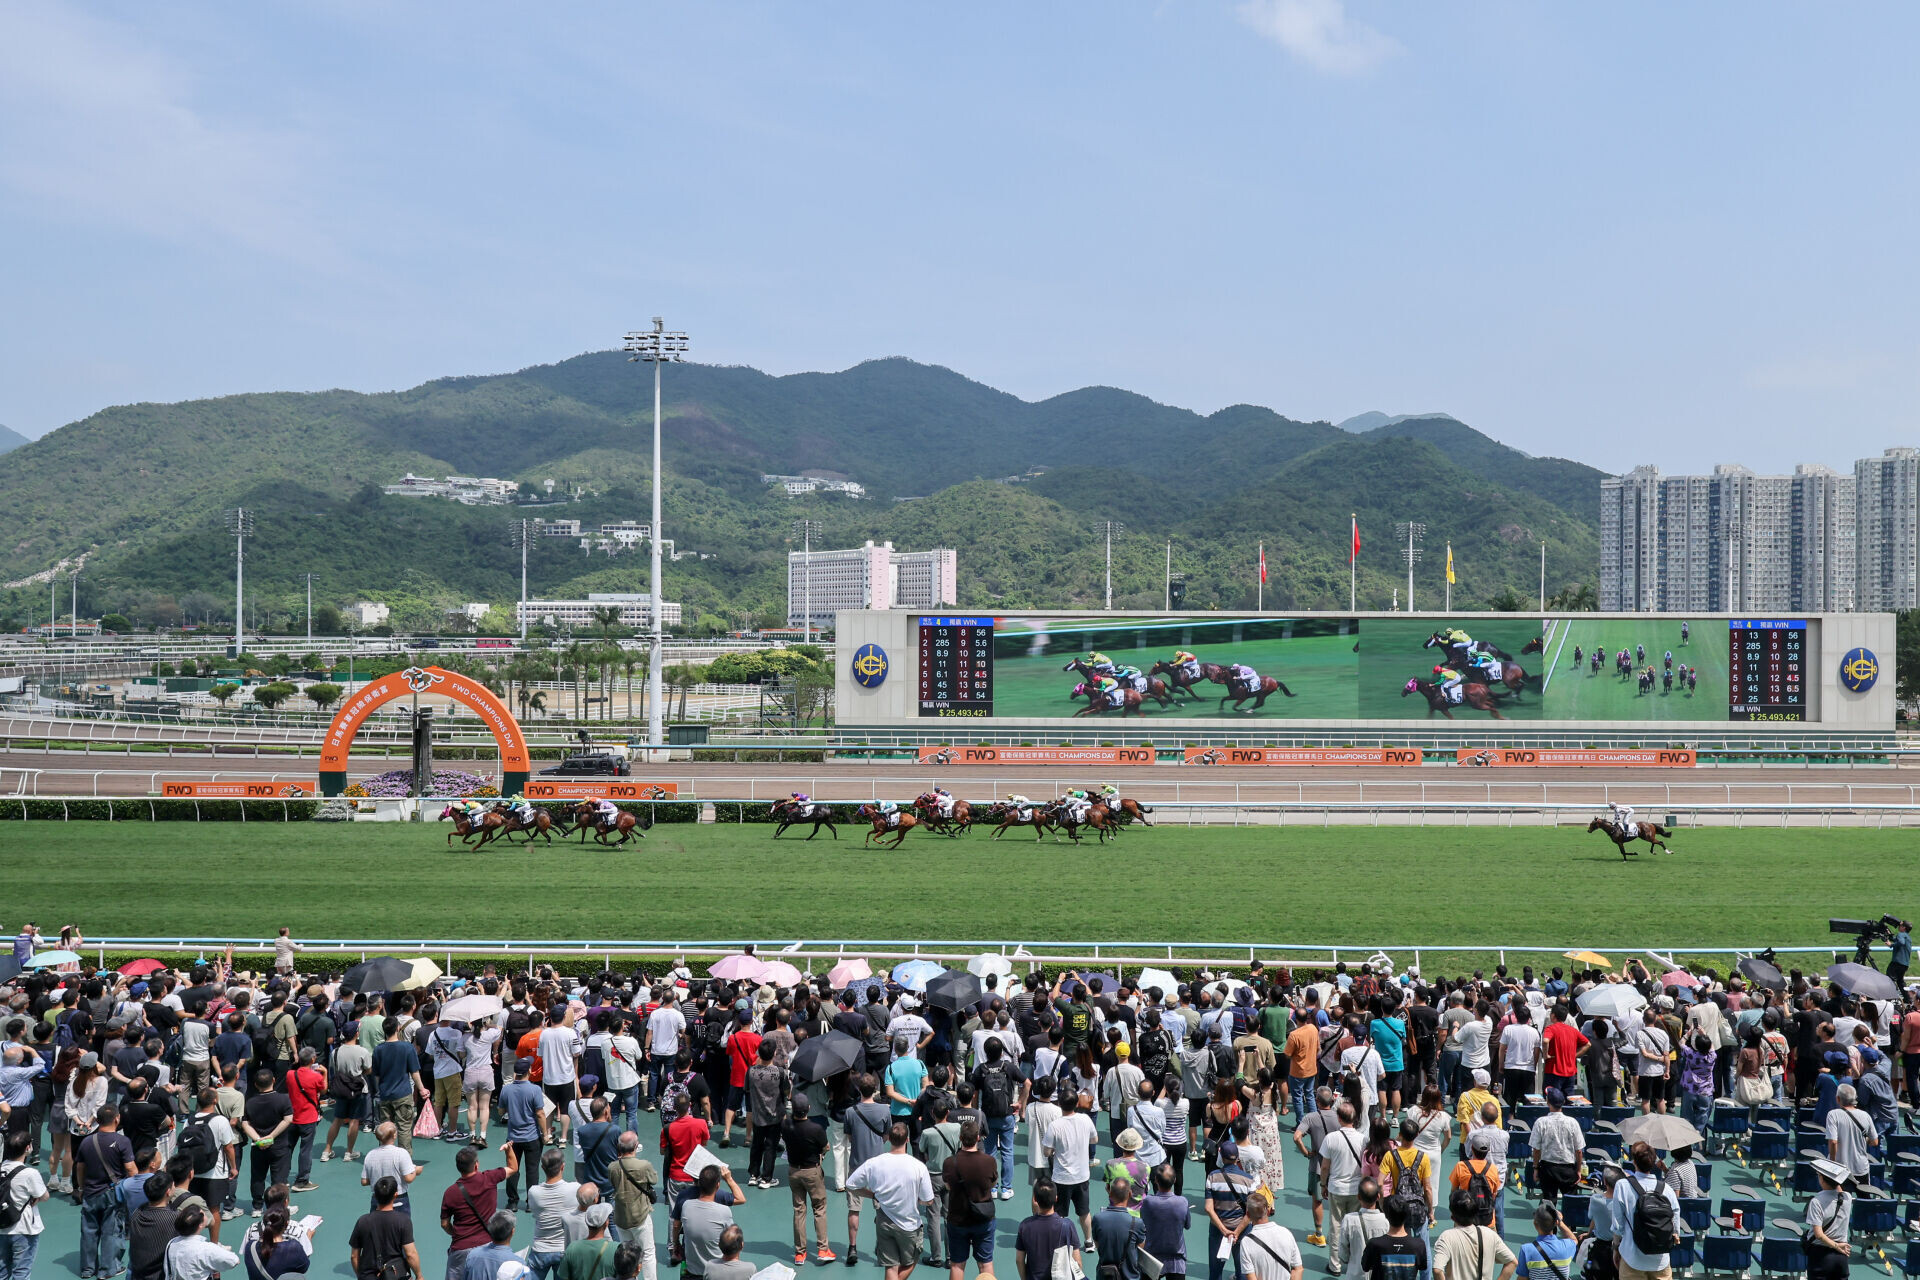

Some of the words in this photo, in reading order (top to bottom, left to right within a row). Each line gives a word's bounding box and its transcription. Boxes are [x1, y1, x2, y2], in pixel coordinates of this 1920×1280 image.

[452, 683, 469, 696] FWD
[470, 693, 508, 733] CHAMPIONS
[504, 733, 515, 749] DAY
[967, 750, 996, 760] FWD
[1119, 751, 1149, 761] FWD
[1232, 751, 1261, 761] FWD
[1386, 752, 1415, 762] FWD
[1505, 752, 1535, 762] FWD
[1660, 753, 1689, 763] FWD
[167, 786, 192, 795] FWD
[248, 786, 273, 795] FWD
[529, 786, 554, 795] FWD
[611, 787, 636, 796] FWD
